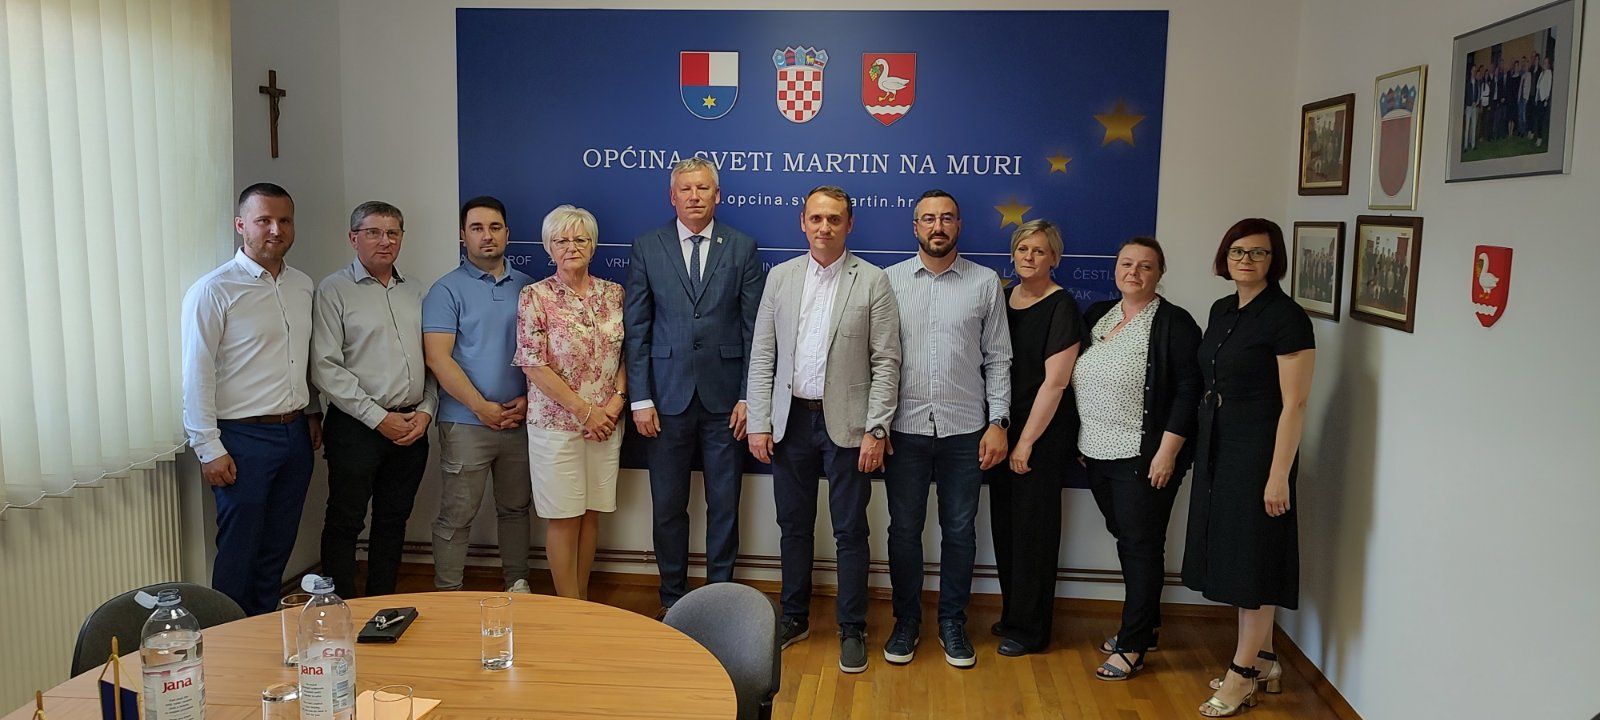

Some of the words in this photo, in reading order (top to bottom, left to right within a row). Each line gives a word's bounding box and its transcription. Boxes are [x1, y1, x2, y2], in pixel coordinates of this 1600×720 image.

[583, 146, 681, 170] OPĆINA
[782, 152, 889, 174] MARTIN
[899, 154, 937, 175] NA
[947, 154, 1023, 176] MURI
[162, 677, 193, 694] Jana
